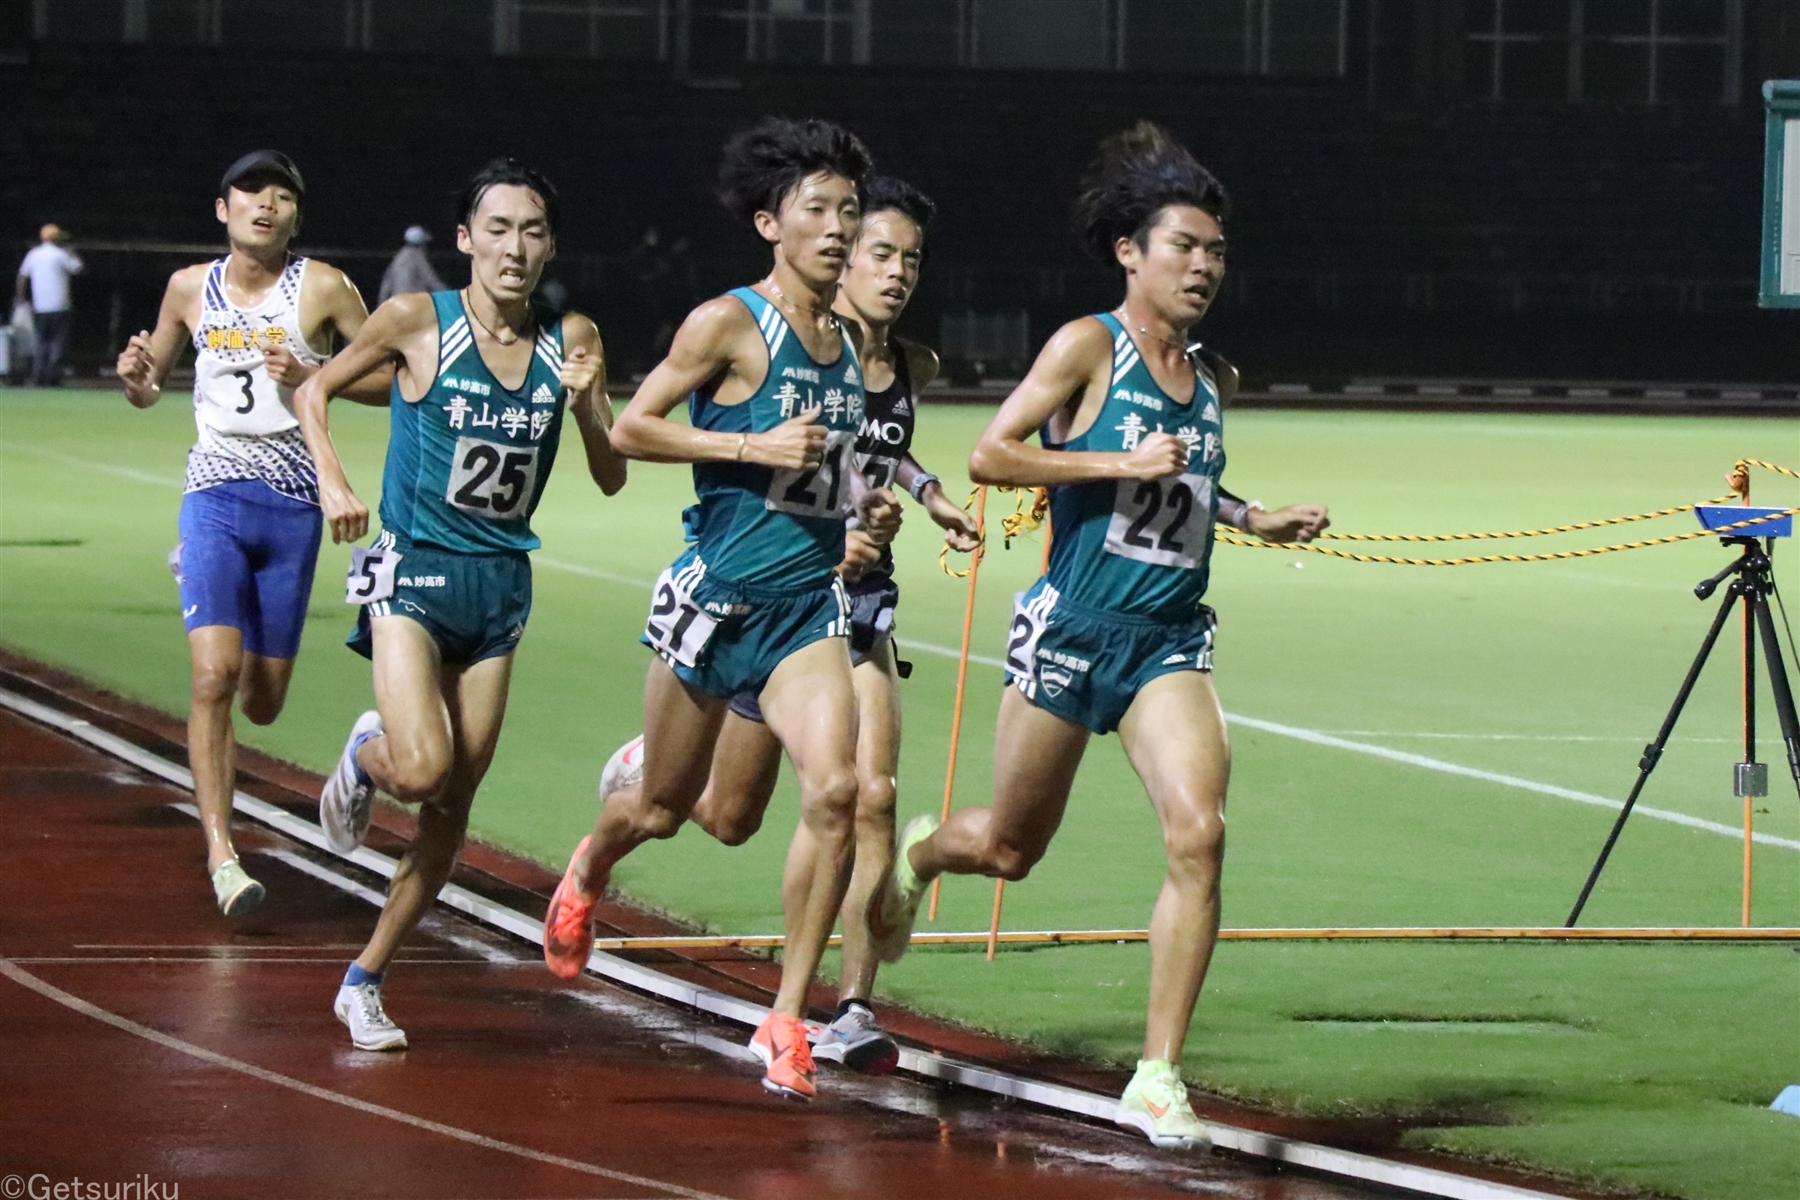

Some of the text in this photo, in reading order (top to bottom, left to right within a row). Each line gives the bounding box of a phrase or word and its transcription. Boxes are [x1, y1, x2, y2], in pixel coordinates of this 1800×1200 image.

[207, 327, 287, 350] 創価大学
[233, 370, 255, 415] 3
[459, 379, 492, 396] 妙高市
[772, 381, 864, 425] 青山学院
[442, 395, 554, 441] 青山学院
[857, 418, 905, 445] MO
[1115, 412, 1222, 464] 青学院
[454, 445, 533, 513] 25
[783, 444, 844, 511] 21
[1122, 480, 1193, 554] 22
[346, 556, 383, 597] 5
[414, 576, 446, 587] 妙高市
[648, 583, 699, 653] 21
[1053, 652, 1092, 673] 妙高市
